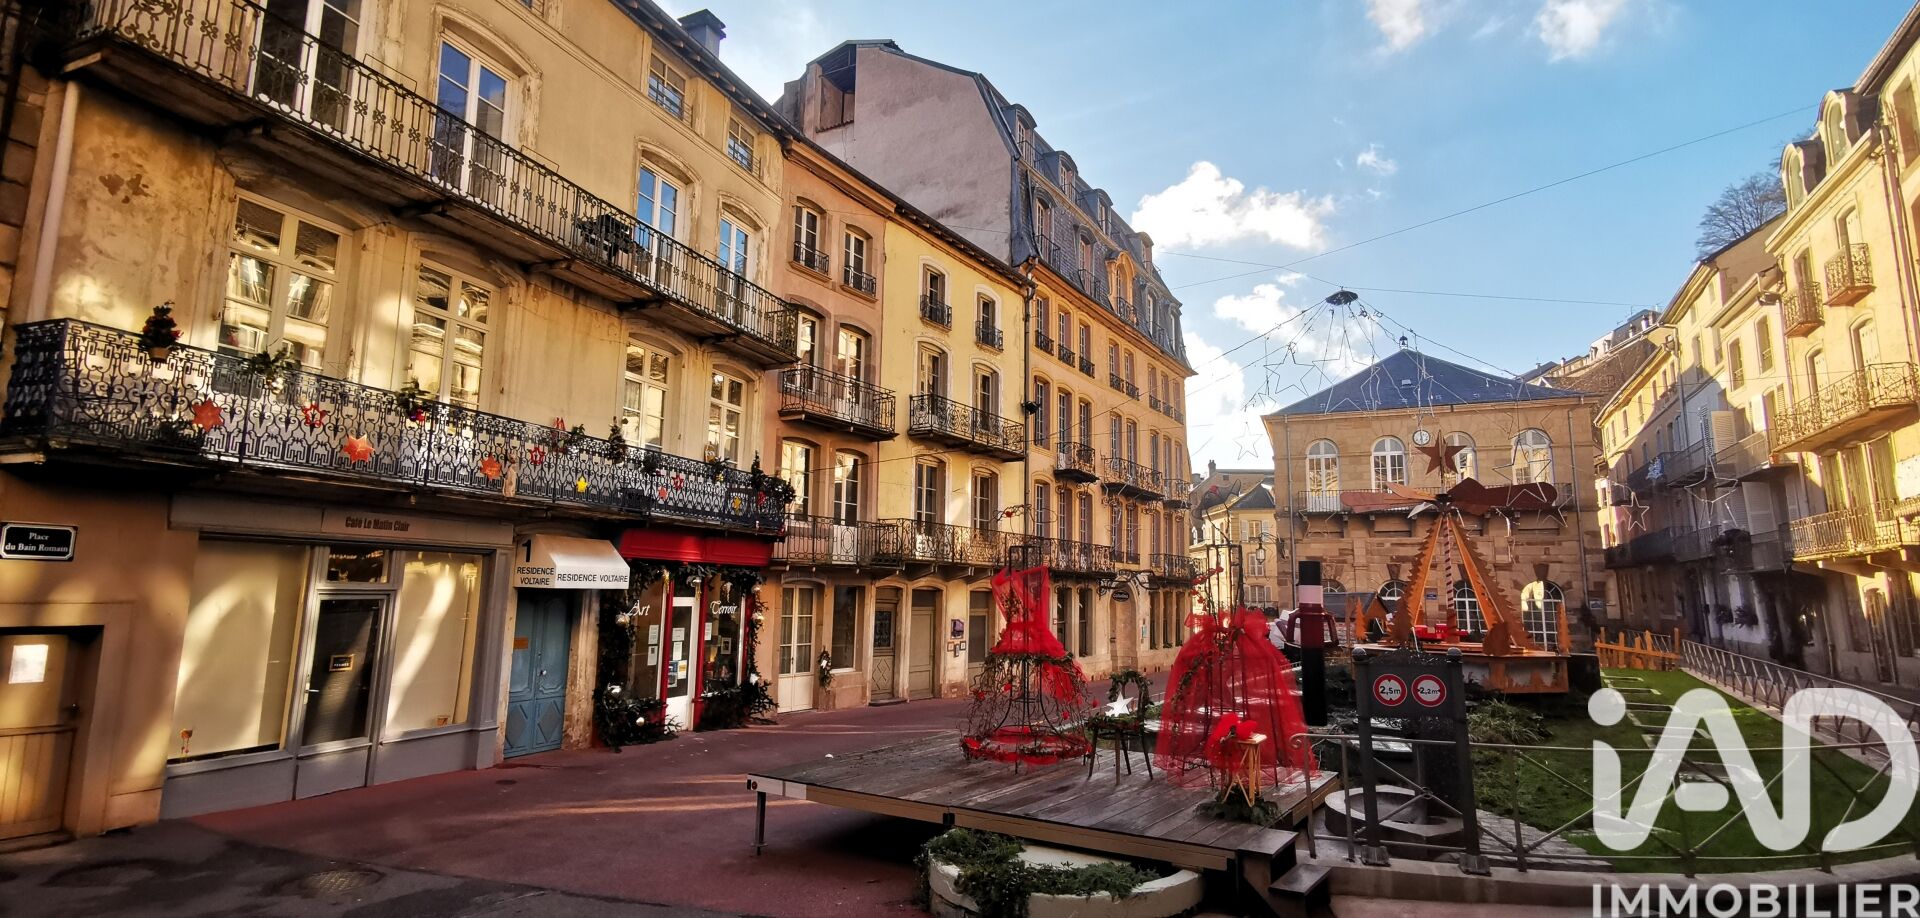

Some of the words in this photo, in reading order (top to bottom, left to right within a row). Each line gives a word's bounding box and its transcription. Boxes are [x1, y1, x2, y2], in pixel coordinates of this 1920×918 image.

[372, 518, 393, 530] Matin
[393, 520, 410, 532] Clair
[17, 543, 37, 551] Bain
[38, 544, 69, 552] Romain
[522, 540, 532, 563] 1
[516, 566, 555, 576] RESIDENCE
[520, 577, 550, 586] VOLTAIRE
[557, 573, 597, 582] RESIDENCE
[599, 574, 629, 583] VOLTAIRE
[627, 599, 650, 616] Art
[710, 600, 738, 615] Terroir
